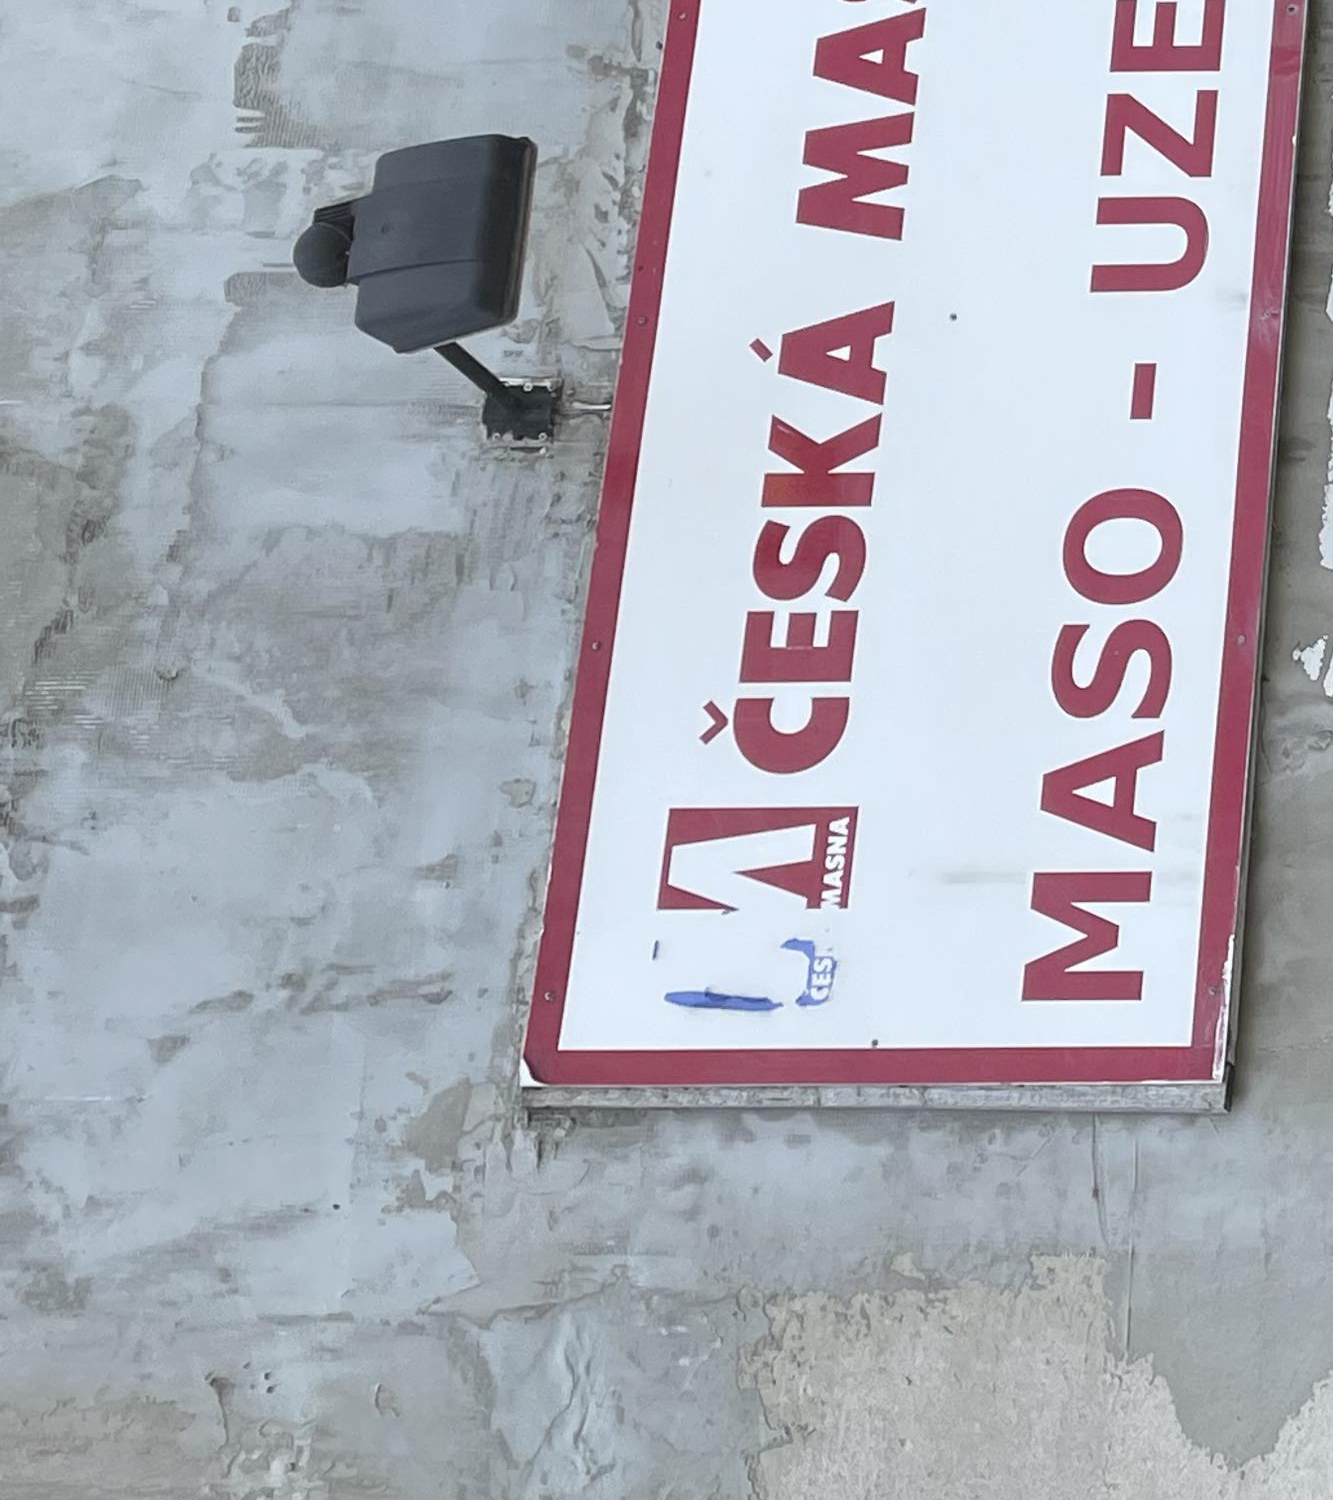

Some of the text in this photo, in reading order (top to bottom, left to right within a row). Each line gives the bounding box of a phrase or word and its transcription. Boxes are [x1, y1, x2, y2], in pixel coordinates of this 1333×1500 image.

[704, 304, 893, 772] ČESKÁ
[1024, 488, 1182, 999] MASO
[1132, 364, 1155, 418] -
[820, 816, 850, 909] MASNA
